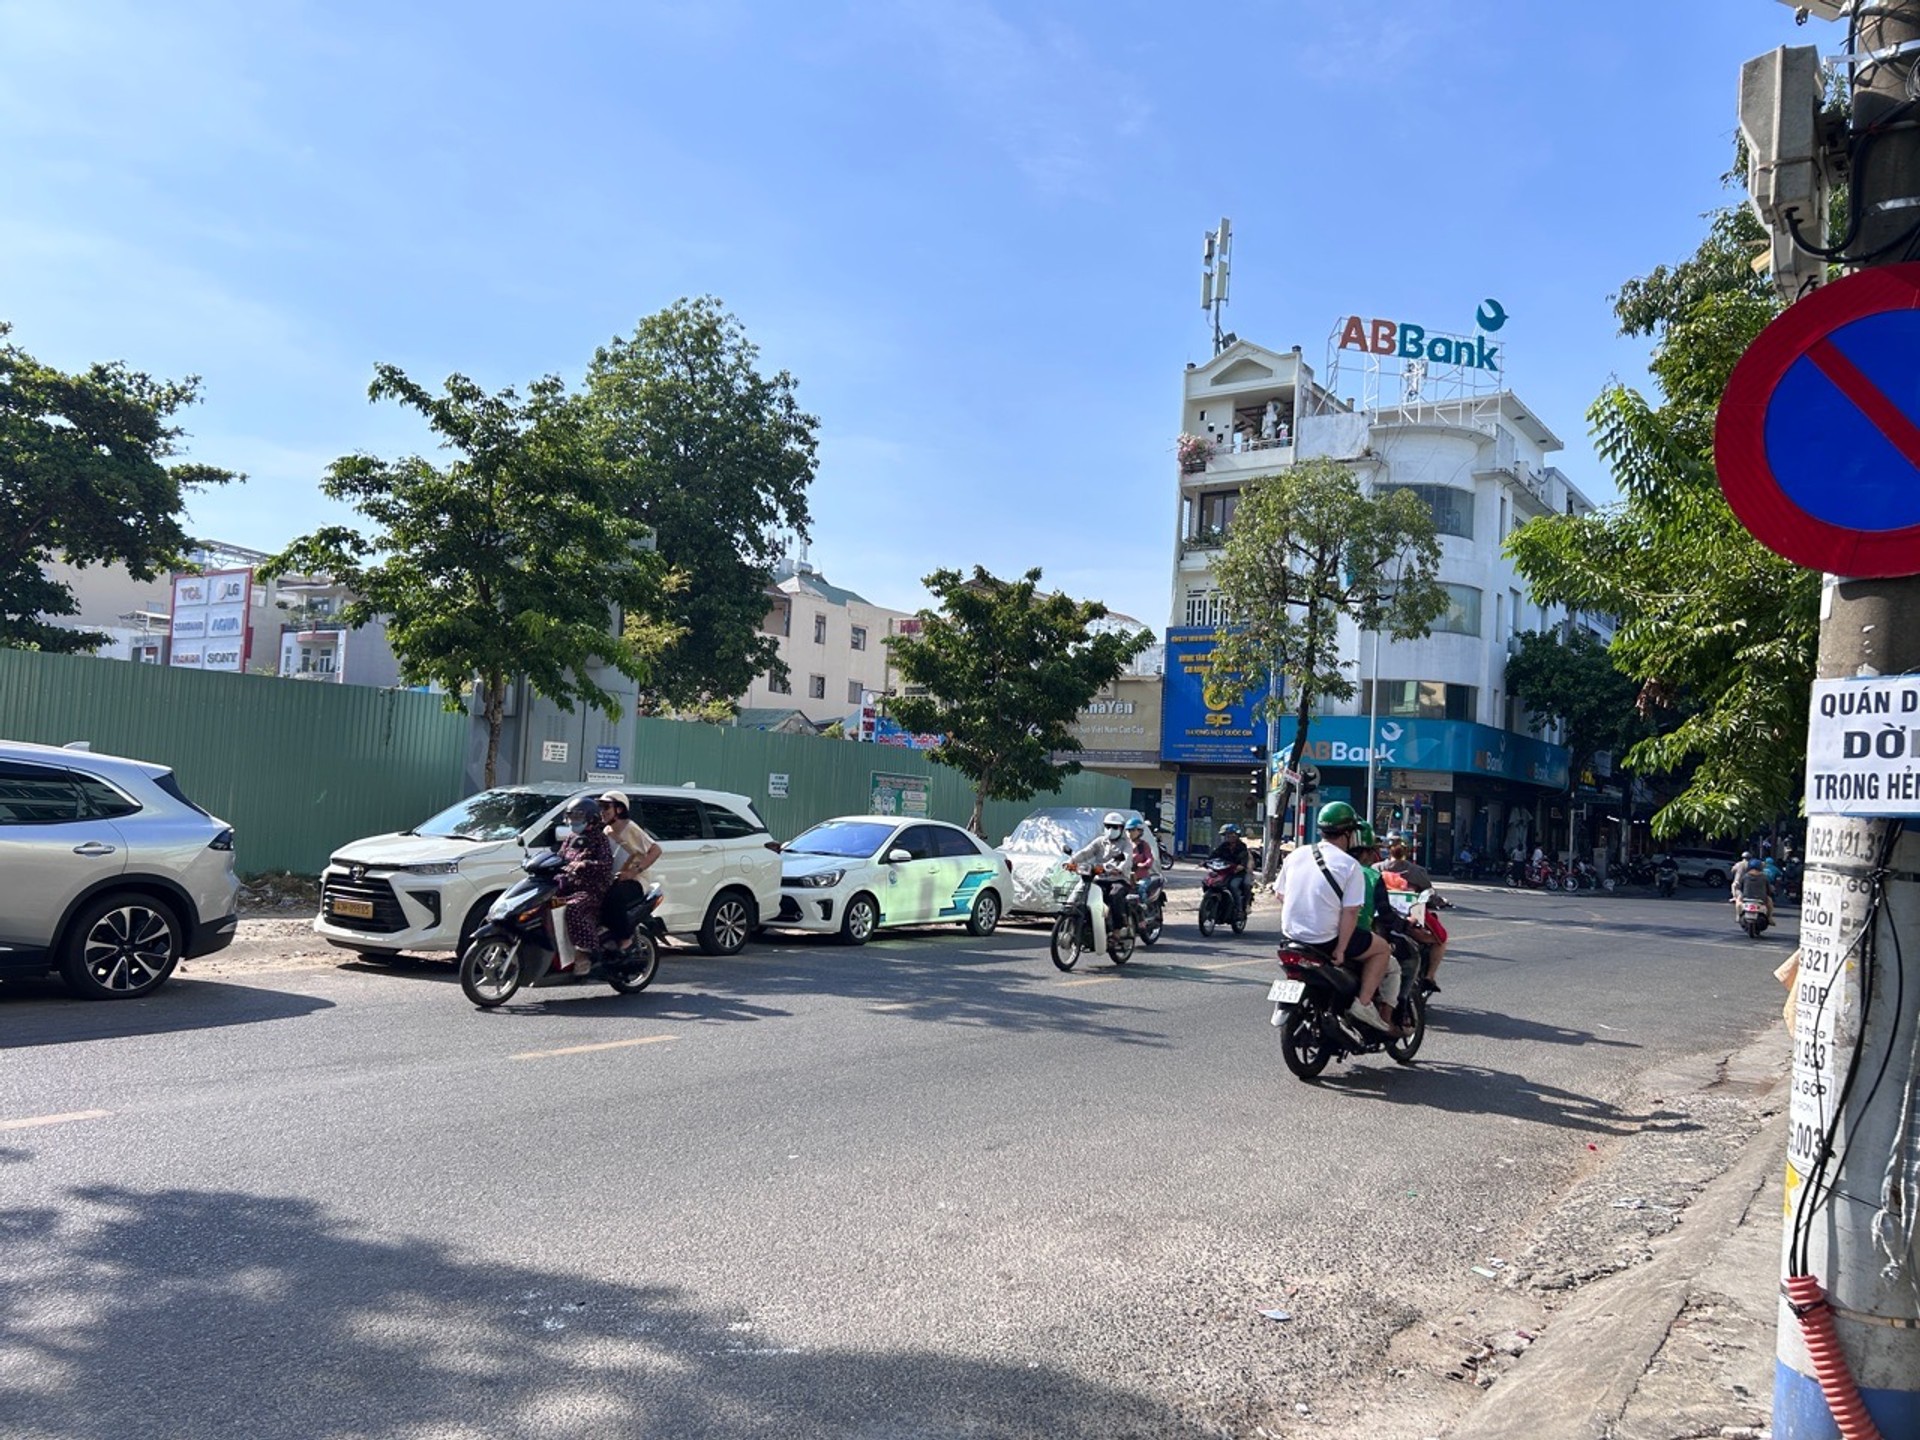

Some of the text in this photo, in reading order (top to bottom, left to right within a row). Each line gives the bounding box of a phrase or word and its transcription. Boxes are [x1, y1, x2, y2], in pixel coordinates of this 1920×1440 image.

[1339, 316, 1499, 371] ABBank
[207, 652, 238, 664] SONY
[1820, 685, 1891, 719] QUÁN
[1205, 713, 1232, 728] SJC
[1301, 741, 1397, 763] ABBank
[1814, 773, 1879, 800] TRONG
